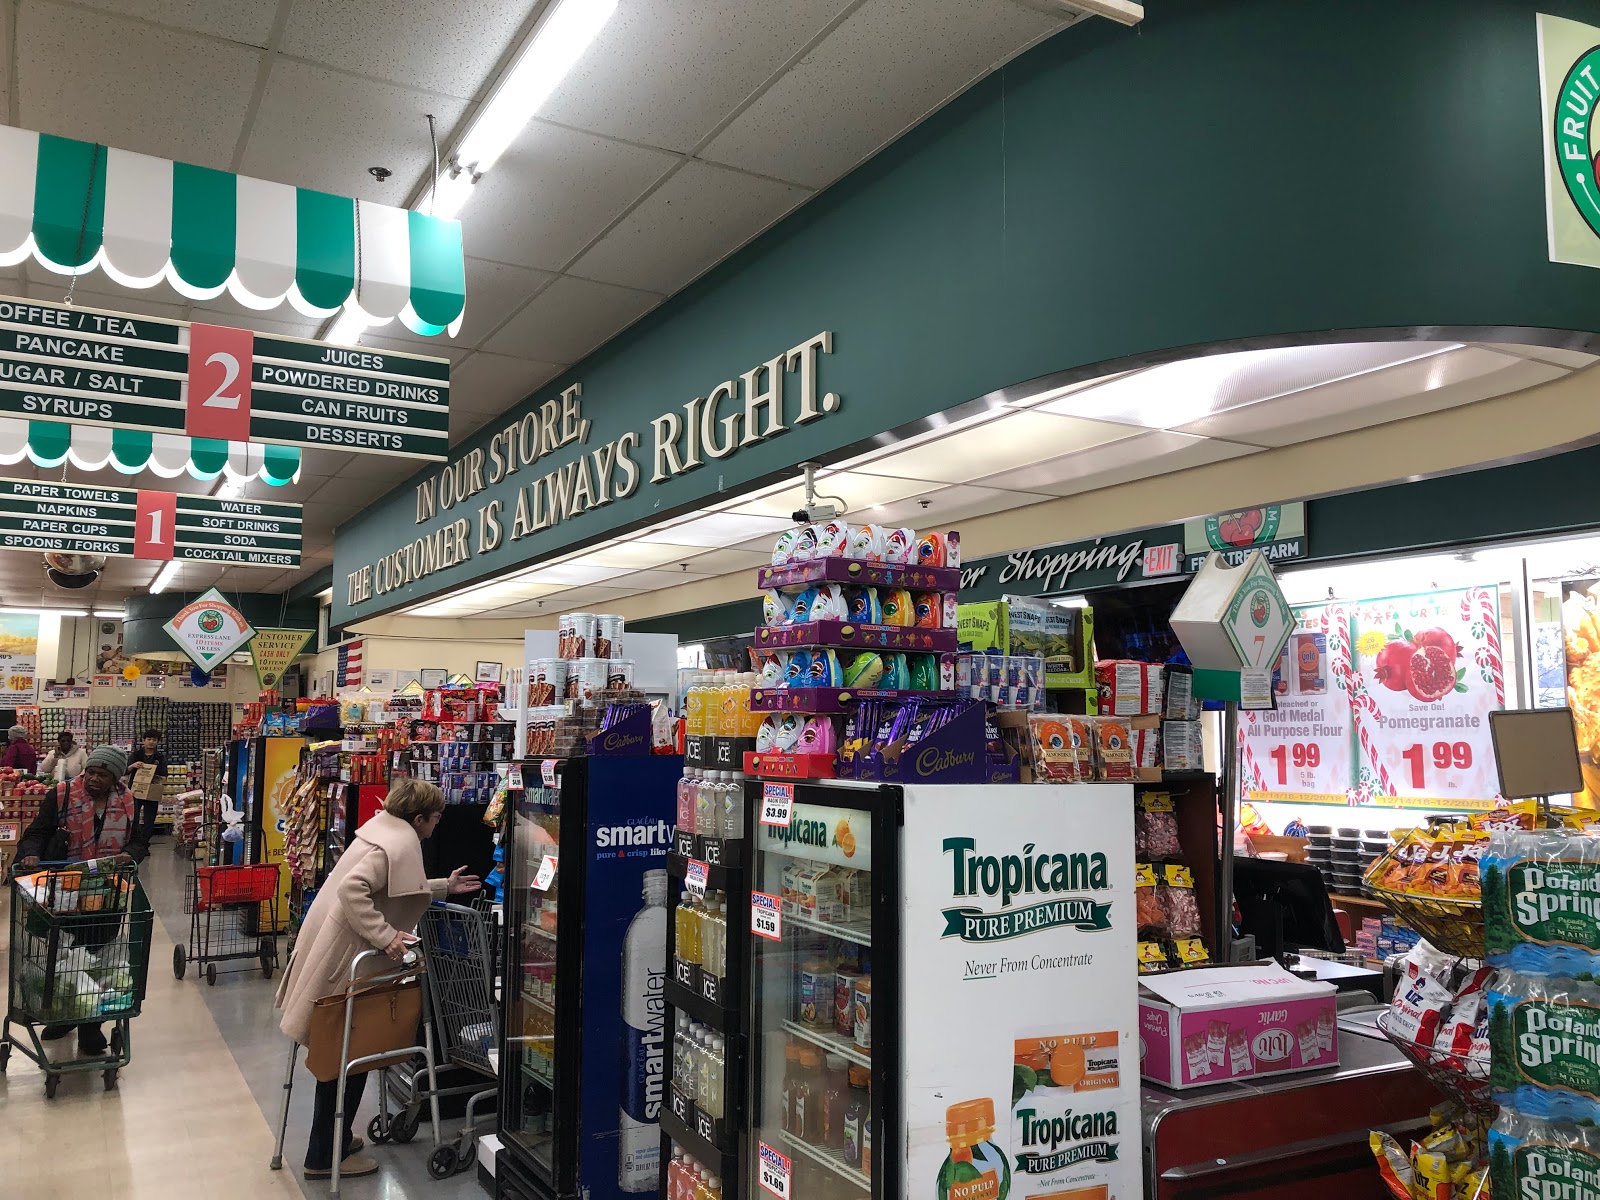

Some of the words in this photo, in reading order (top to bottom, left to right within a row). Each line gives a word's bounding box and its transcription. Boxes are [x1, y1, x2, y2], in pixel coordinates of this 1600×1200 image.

[1563, 65, 1600, 161] FRUIT
[93, 317, 138, 337] TEA
[15, 335, 124, 363] PANCAKE
[321, 349, 384, 370] JUICES
[89, 373, 143, 394] SALT
[202, 352, 242, 410] 2
[262, 367, 370, 394] POWDERED
[375, 382, 439, 403] DRINKS
[22, 395, 113, 419] SYRUPS
[301, 399, 341, 415] CAN
[345, 403, 408, 424] FRUITS
[306, 426, 403, 449] DESSERTS
[415, 473, 437, 524] IN
[440, 447, 487, 511] OUR
[489, 383, 590, 484] STORE,
[347, 567, 372, 607] THE
[375, 515, 471, 595] CUSTOMER
[477, 499, 503, 555] IS
[510, 432, 640, 542] ALWAYS
[649, 330, 840, 484] RIGHT.
[13, 483, 60, 497] PAPER
[63, 487, 120, 502] TOWELS
[37, 503, 97, 517] NAPKINS
[221, 502, 262, 514] WATER
[23, 520, 68, 533] PAPER
[72, 523, 108, 535] CUPS
[146, 509, 166, 545] 1
[202, 517, 236, 529] SOFT
[239, 519, 280, 532] DRINKS
[4, 535, 63, 549] SPOONS
[74, 539, 120, 552] FORKS
[223, 534, 257, 546] SODA
[184, 547, 246, 561] COCKTAIL
[248, 552, 292, 565] MIXERS
[1149, 546, 1173, 572] EXIT
[1262, 542, 1299, 560] FARM
[960, 564, 987, 590] or
[999, 538, 1144, 591] Shopping
[177, 610, 190, 623] Thank
[208, 602, 231, 613] Shopping
[254, 633, 302, 641] CUSTOMER
[1254, 636, 1265, 666] 7
[1263, 710, 1288, 722] Gold
[1290, 710, 1324, 722] Medal
[1409, 704, 1429, 712] Save
[1431, 703, 1445, 711] On!
[1248, 725, 1262, 737] All
[1264, 724, 1310, 739] Purpose
[1313, 724, 1343, 737] Flour
[1380, 714, 1480, 731] Pomegranate
[604, 733, 643, 751] Cadbury
[916, 747, 974, 776] Cadbury
[1271, 745, 1287, 785] 1
[1293, 743, 1321, 768] 99
[1402, 744, 1425, 789] 1
[1432, 742, 1472, 769] 99
[1302, 779, 1315, 789] bag
[766, 808, 787, 818] $3.99
[943, 837, 1110, 909] Tropicana
[1523, 868, 1600, 892] Poland
[757, 918, 774, 932] $1.59
[964, 915, 1010, 939] PURE
[1014, 901, 1093, 933] PREMIUM
[1558, 929, 1588, 939] MAINE
[964, 960, 997, 976] Never
[1000, 957, 1028, 973] From
[1031, 953, 1093, 970] Concentrate
[1257, 1009, 1288, 1025] Garlic
[1394, 999, 1422, 1020] Original
[1403, 1020, 1416, 1031] CHIPS
[1526, 1008, 1600, 1038] Poland
[1087, 1058, 1118, 1067] Tropicana
[1079, 1078, 1115, 1087] ORIGINAL
[1016, 1109, 1118, 1150] Tropicana
[1028, 1158, 1056, 1172] PURE
[1058, 1144, 1108, 1166] PREMIUM
[1526, 1152, 1600, 1188] Poland
[954, 1188, 968, 1198] NO
[972, 1180, 994, 1194] PULP
